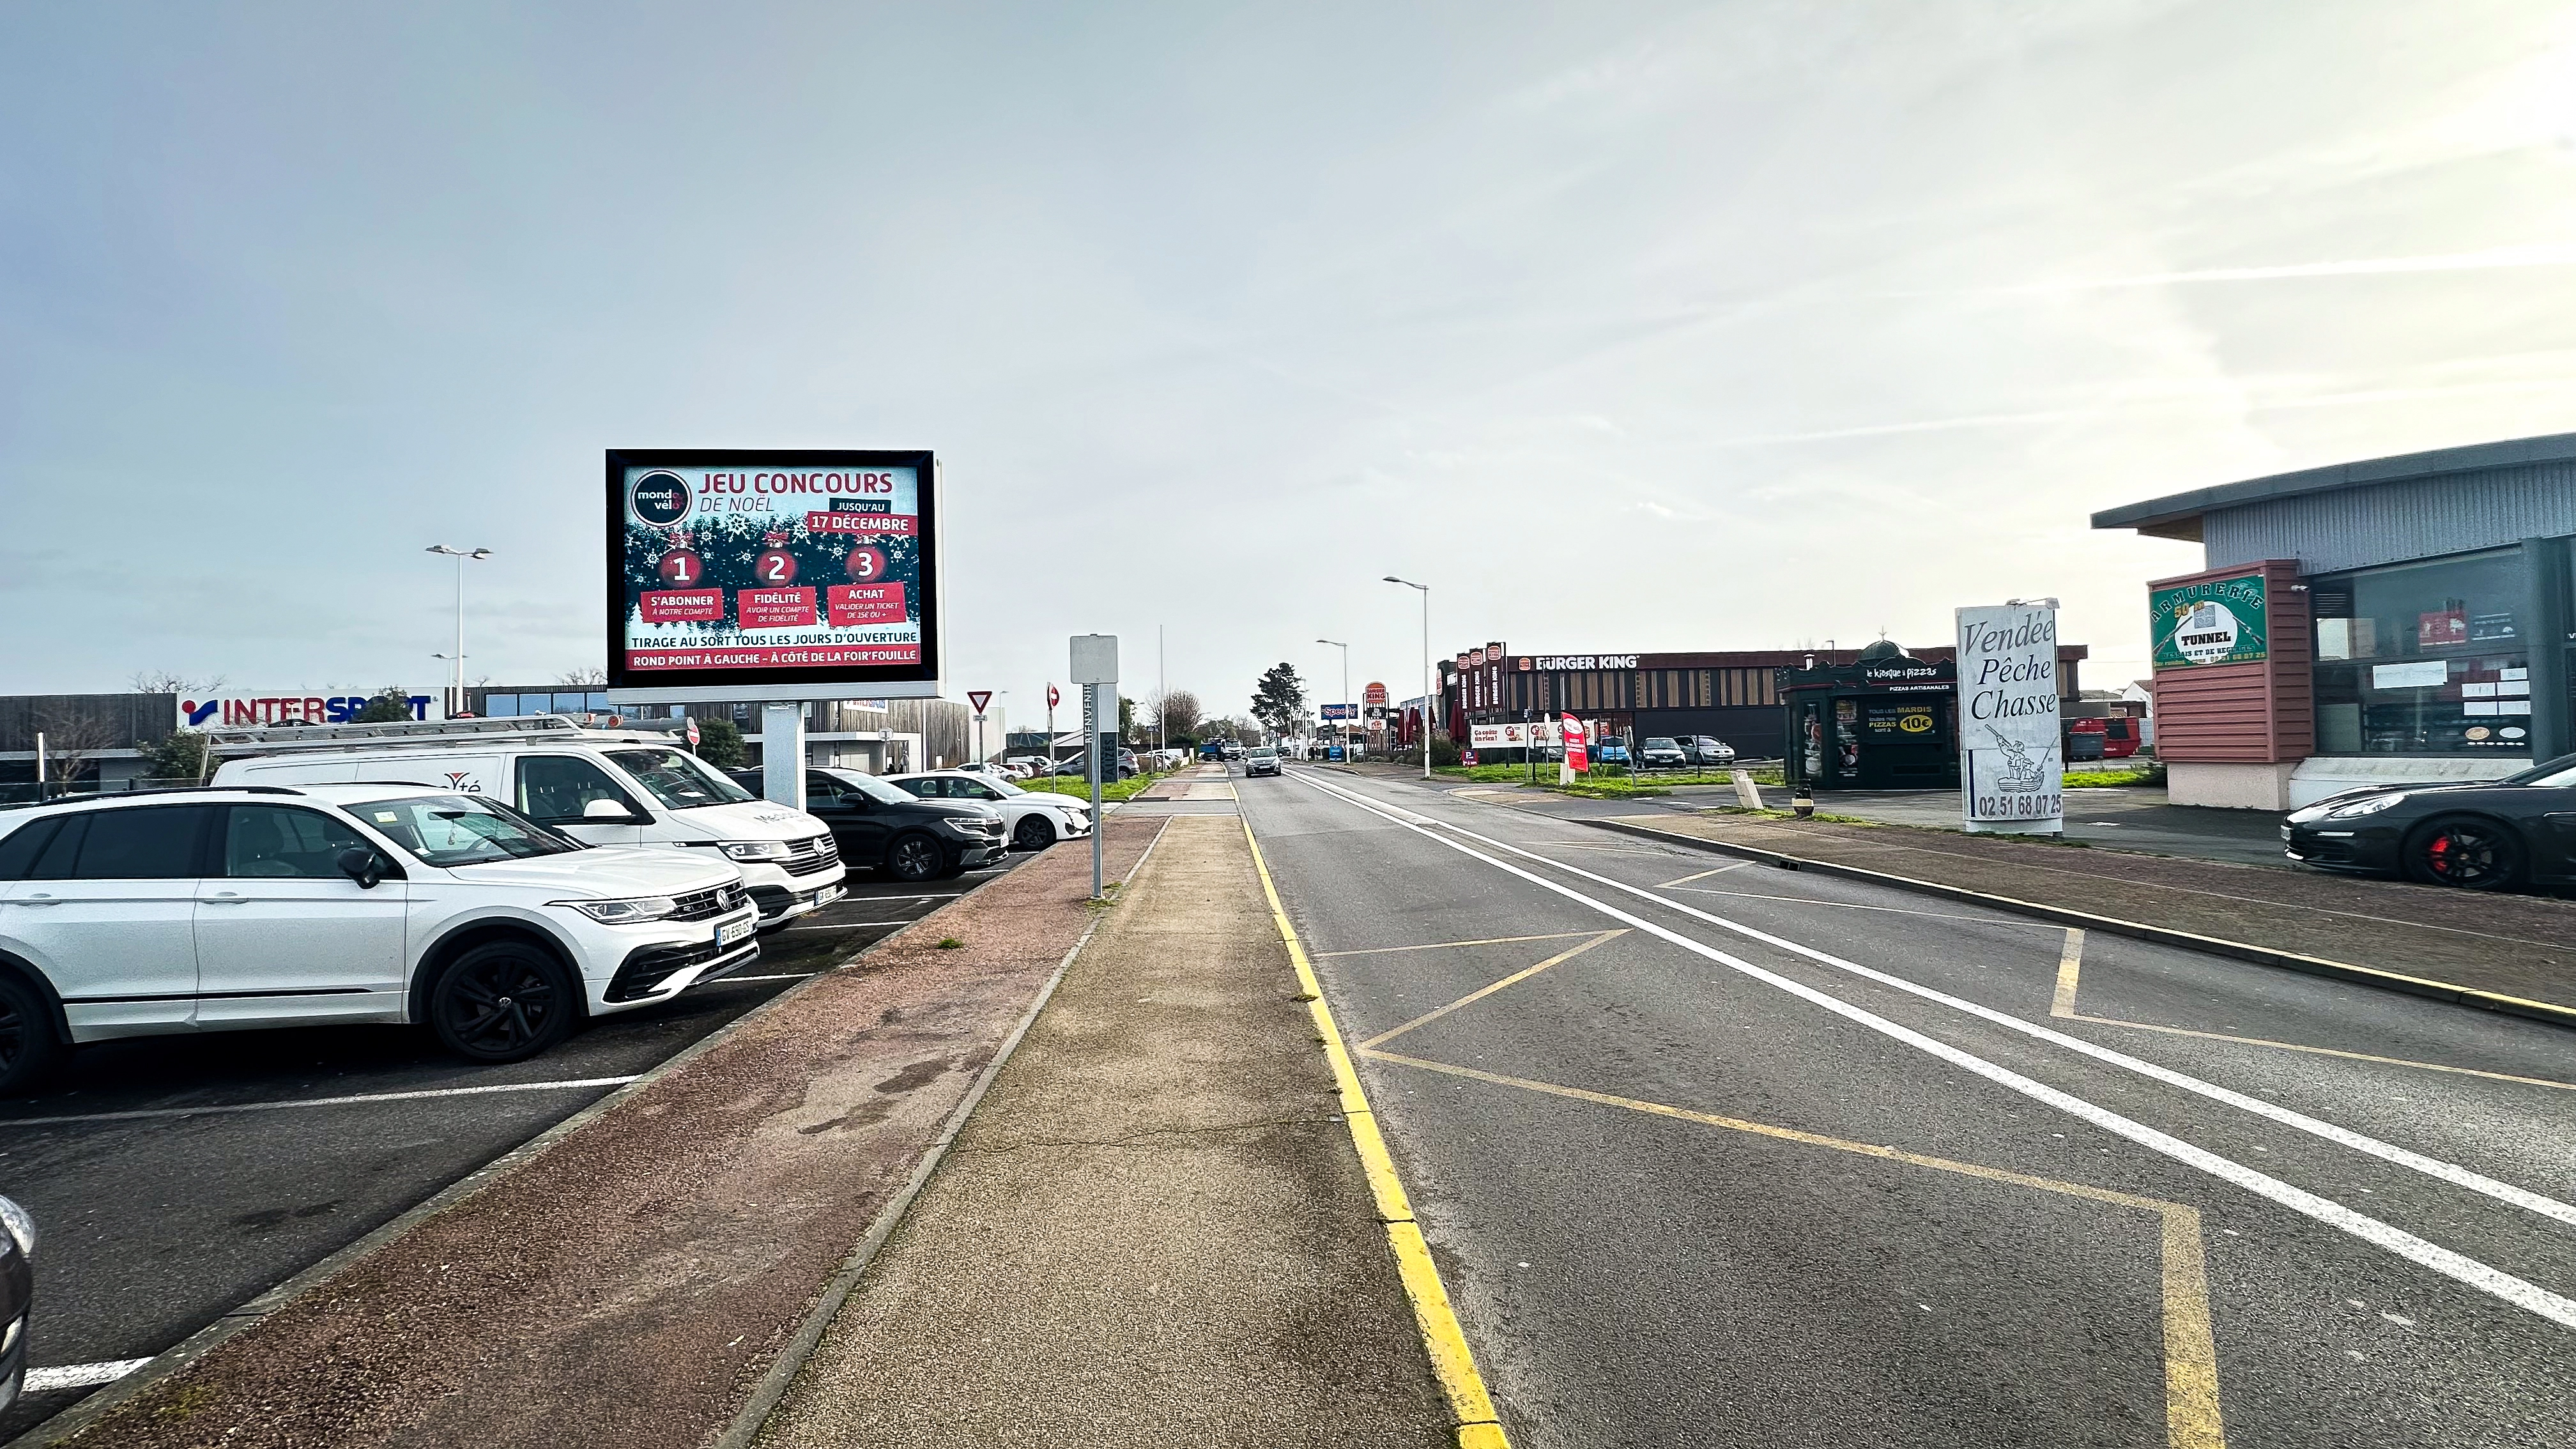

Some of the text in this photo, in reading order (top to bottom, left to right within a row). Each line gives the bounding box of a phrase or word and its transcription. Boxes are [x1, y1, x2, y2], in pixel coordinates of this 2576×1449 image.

[698, 473, 893, 494] JEU CONCOURS
[700, 494, 774, 512] DE NOËL
[836, 502, 885, 512] JUSQU'AU
[812, 514, 908, 531] 17 DÉCEMBRE
[673, 556, 690, 581] 1
[769, 556, 785, 580] 2
[858, 552, 873, 576] 3
[650, 596, 714, 606] S'ABONNER
[754, 592, 801, 604] FIDÉLITÉ
[848, 590, 885, 599] ACHAT
[2150, 583, 2264, 622] ARMURERIE
[768, 614, 799, 622] FIDÉLITÉ
[2174, 604, 2190, 619] 50
[632, 632, 917, 648] TIRAGE AU SORT TOUS LES JOURS D'OUVERTURE
[1964, 611, 2053, 656] Vendée
[2181, 631, 2231, 647] TUNNEL
[634, 656, 666, 666] ROND
[668, 656, 702, 666] POINT
[703, 653, 712, 664] À
[714, 654, 760, 664] GAUCHE
[770, 652, 779, 663] À
[781, 650, 808, 663] CÔTÉ
[811, 652, 825, 662] DE
[827, 652, 841, 661] LA
[844, 650, 916, 661] FOIR'FOUILLE
[1535, 656, 1637, 670] BURGER KING
[1874, 668, 1901, 679] kiosque
[1907, 668, 1937, 679] pizzas
[1976, 654, 2051, 685] Pêche
[1972, 689, 2056, 719] Chasse
[1903, 717, 1930, 729] 10€
[1105, 739, 1115, 776] ALIZES
[1979, 793, 2062, 816] 02 51 68 07 25
